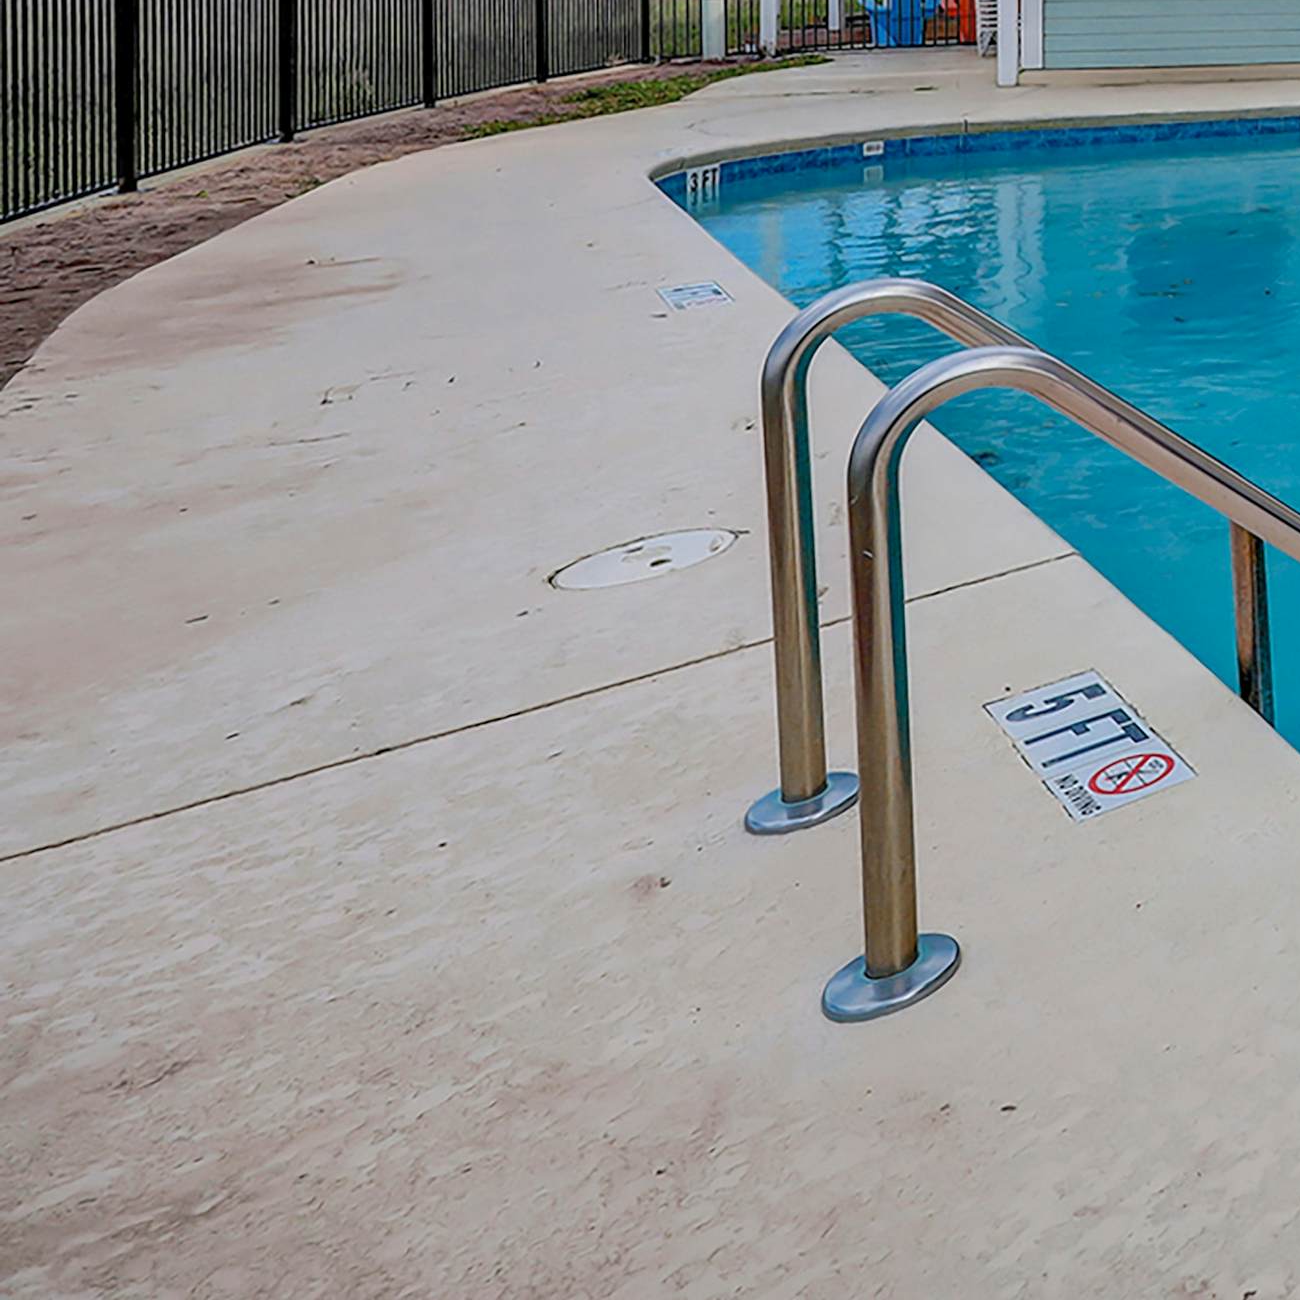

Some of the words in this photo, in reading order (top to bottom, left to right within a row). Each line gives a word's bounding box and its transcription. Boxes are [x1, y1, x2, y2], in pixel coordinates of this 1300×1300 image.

[690, 171, 698, 192] 3
[702, 167, 718, 190] FT
[1006, 682, 1107, 722] 5
[1024, 708, 1150, 769] FT
